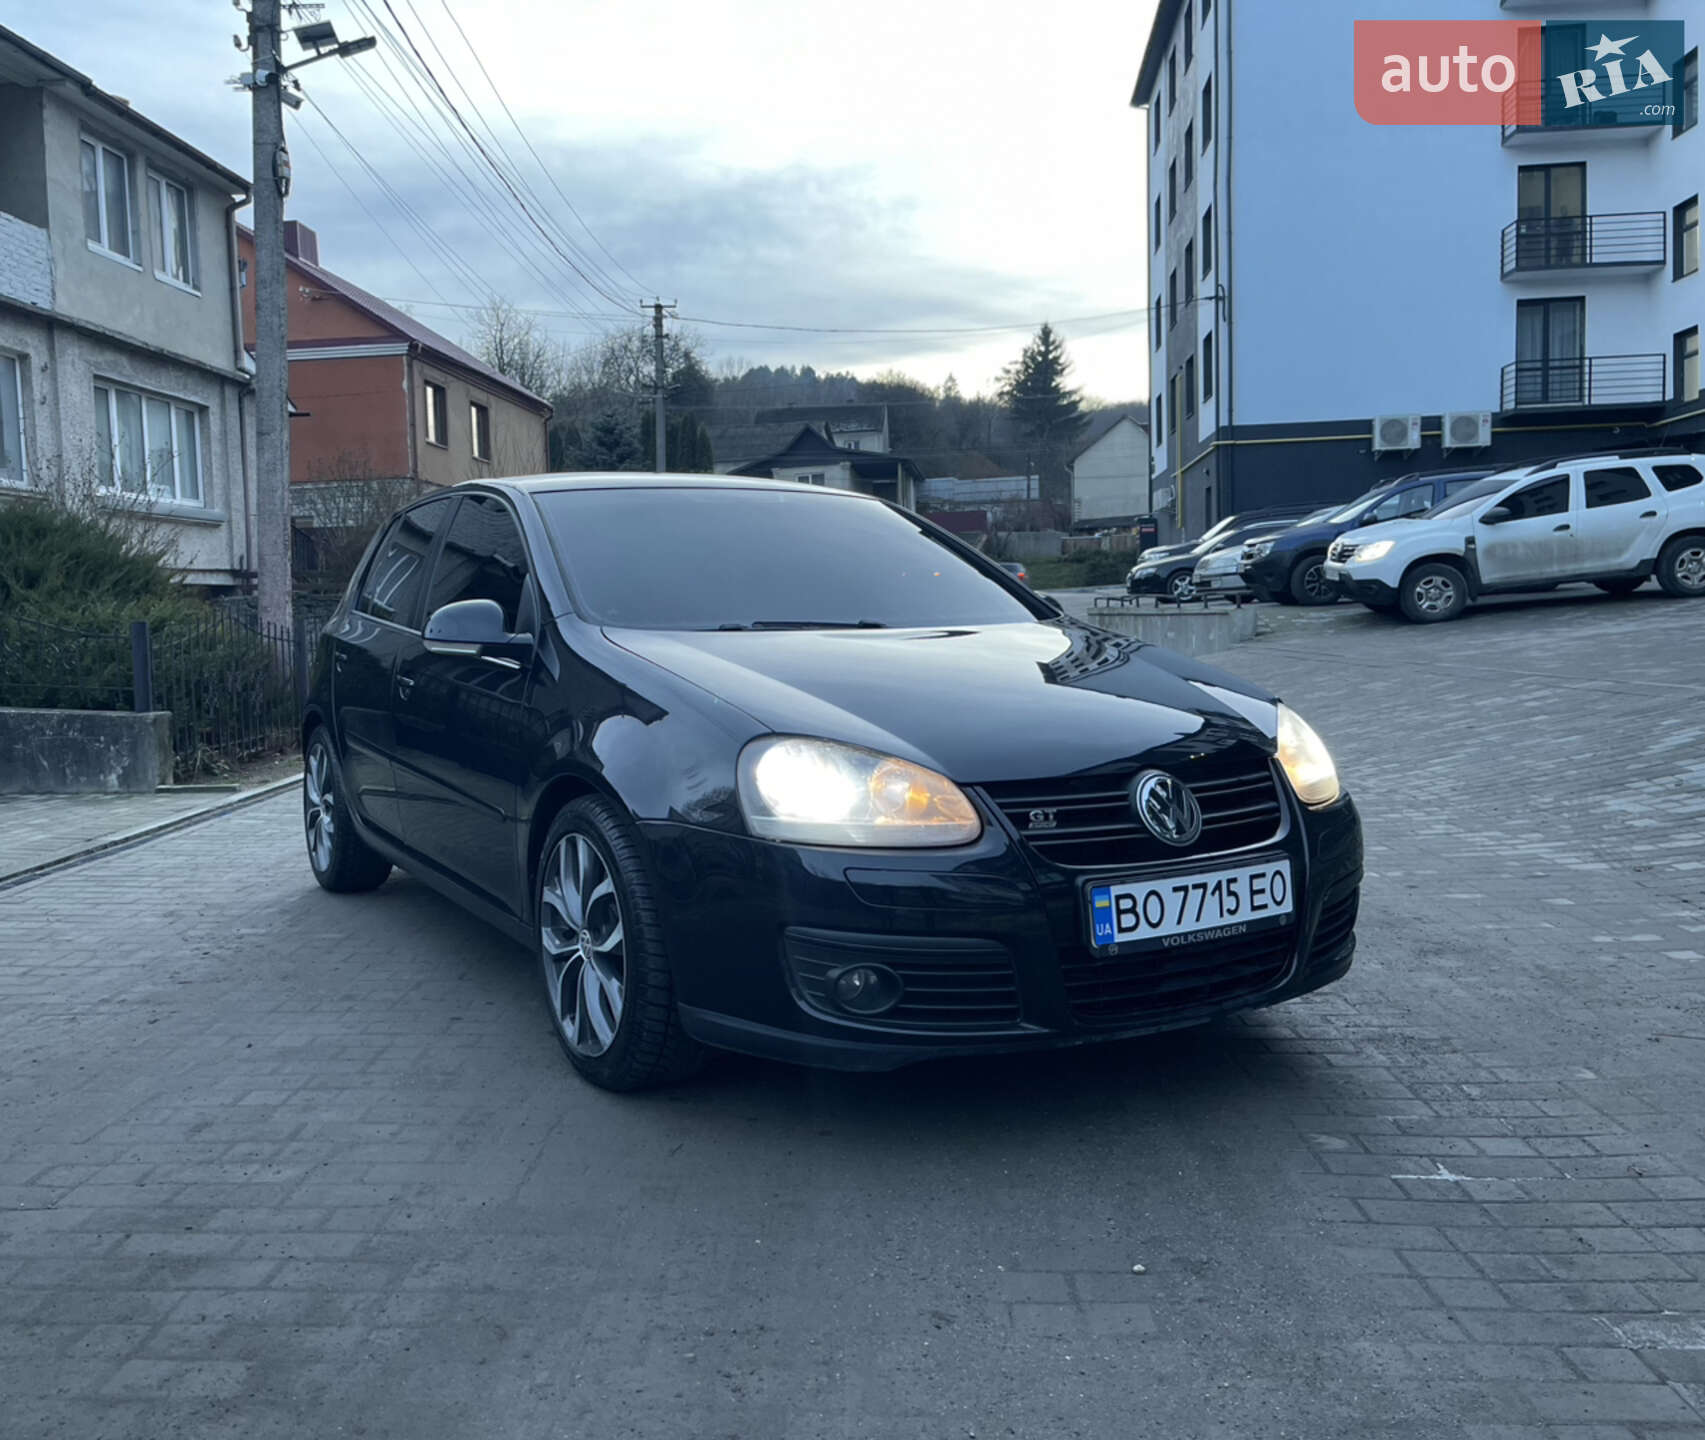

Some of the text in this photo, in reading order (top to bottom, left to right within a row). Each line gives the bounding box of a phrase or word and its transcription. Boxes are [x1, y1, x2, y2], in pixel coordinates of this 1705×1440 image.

[1114, 869, 1287, 934] BO 7715 EO
[1096, 922, 1112, 936] UA
[1162, 923, 1247, 947] VOLKSWAGEN
